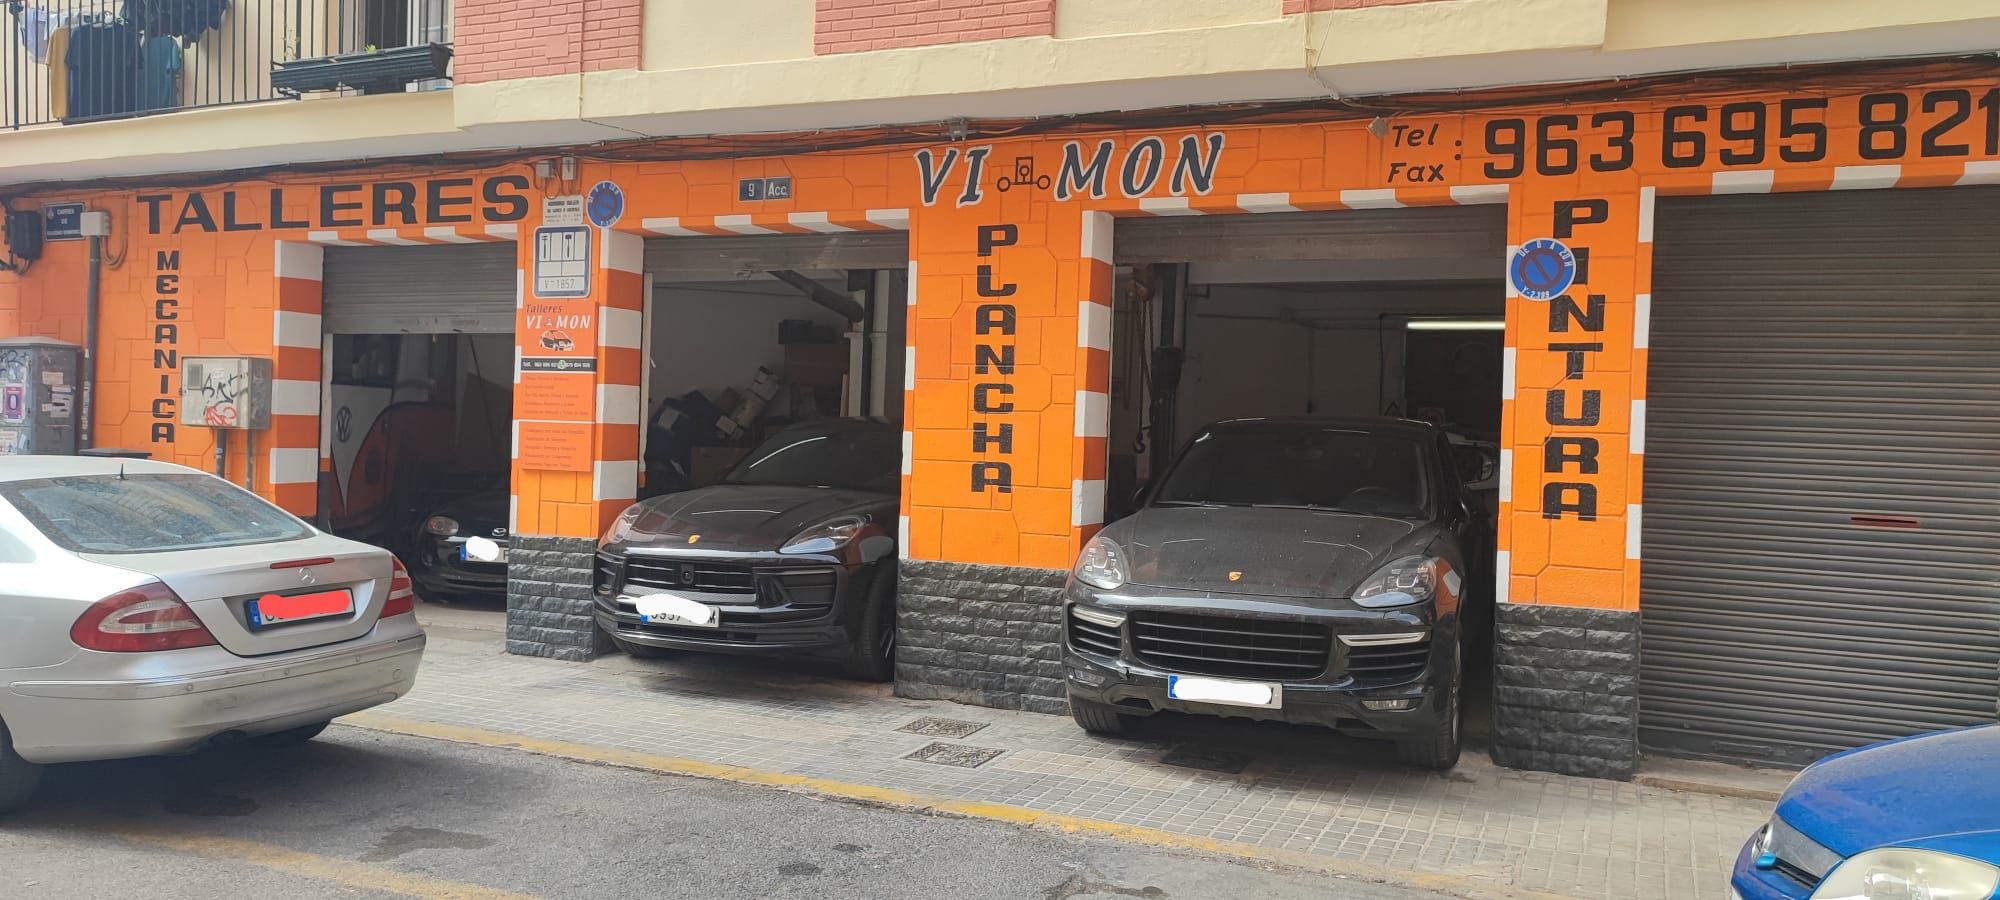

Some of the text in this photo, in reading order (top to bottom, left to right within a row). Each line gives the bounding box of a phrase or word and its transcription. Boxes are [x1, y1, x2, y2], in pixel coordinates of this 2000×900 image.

[1391, 123, 1439, 148] Tel
[1483, 110, 1635, 179] 963
[1661, 97, 1829, 169] 695
[1858, 87, 1999, 160] 821
[748, 183, 755, 197] 9
[914, 131, 1226, 209] VI MON
[1387, 162, 1445, 183] Fax
[136, 174, 529, 235] TALLERES
[1518, 247, 1530, 257] DE
[526, 303, 563, 313] Talleres
[526, 314, 592, 329] VI MON
[151, 250, 180, 443] MECANICA
[970, 223, 1018, 494] PLANCHA
[1541, 198, 1609, 522] PINTURA
